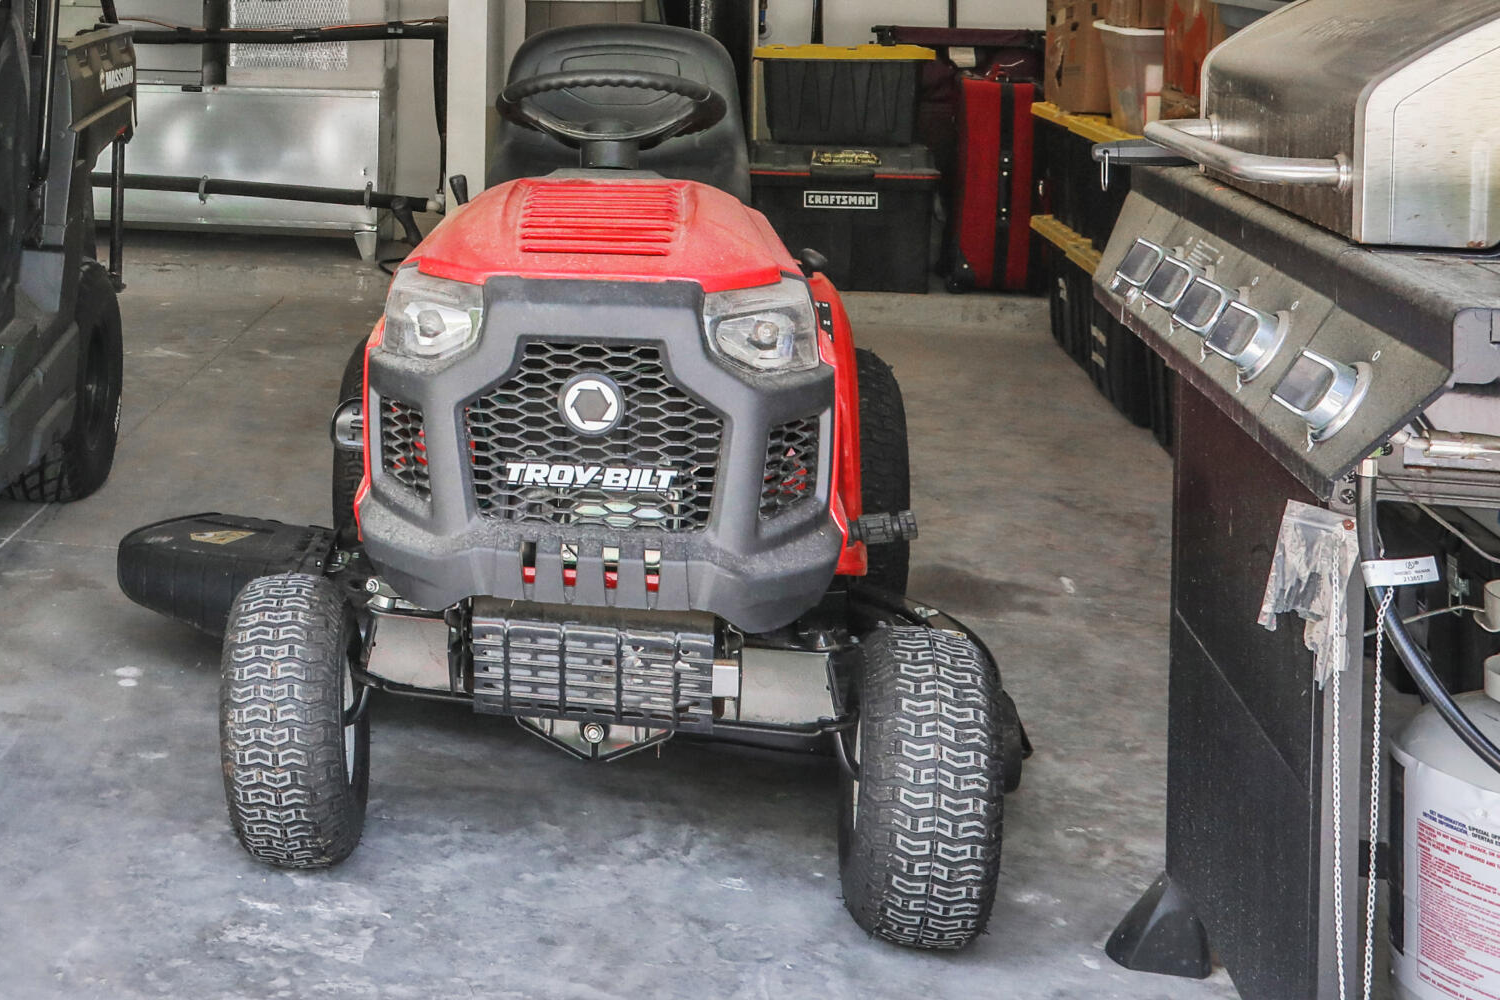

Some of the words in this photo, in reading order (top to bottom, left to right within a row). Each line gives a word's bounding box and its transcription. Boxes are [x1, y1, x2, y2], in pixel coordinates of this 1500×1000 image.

[105, 65, 134, 90] MASSIMO
[807, 194, 875, 206] CRAFTSMAN
[506, 462, 678, 492] TROY-BILT
[1468, 825, 1490, 838] SPECIAL
